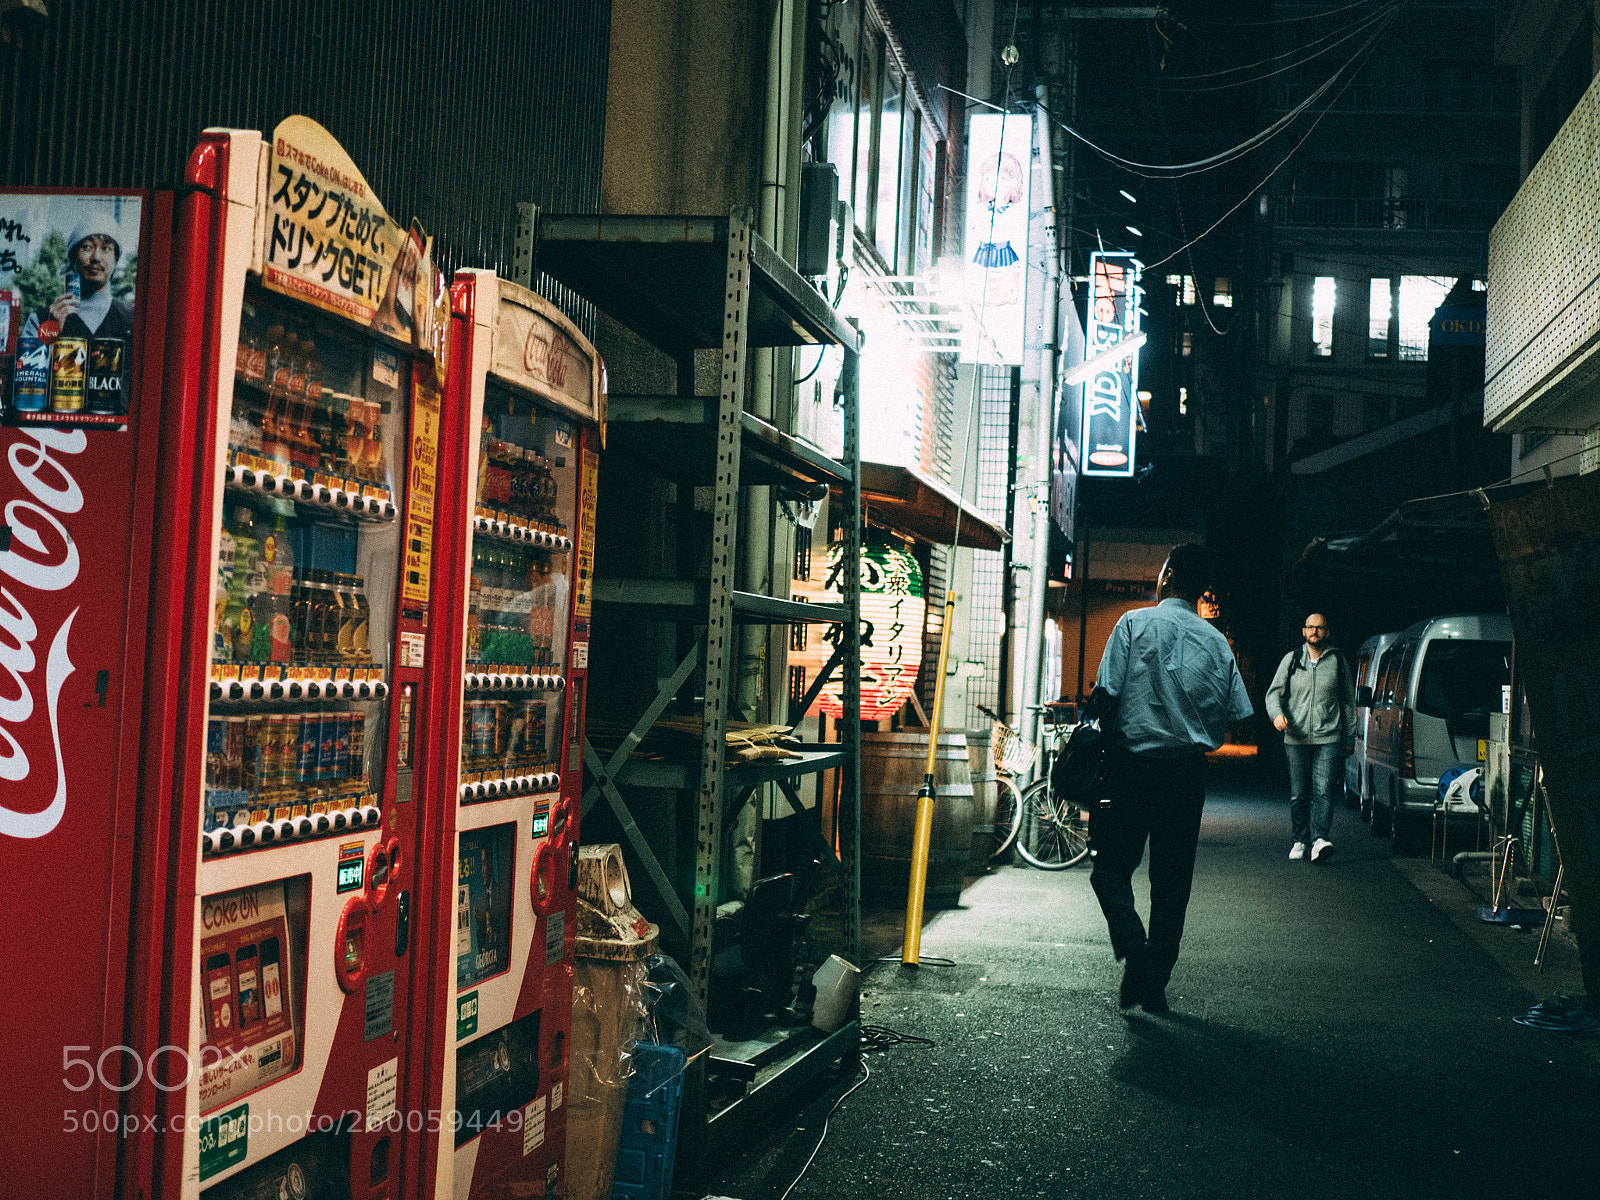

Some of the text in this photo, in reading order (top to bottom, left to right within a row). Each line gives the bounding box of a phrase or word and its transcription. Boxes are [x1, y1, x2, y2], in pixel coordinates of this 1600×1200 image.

[269, 212, 384, 305] ドリンクGET!
[40, 328, 58, 338] New
[202, 900, 239, 931] Coke
